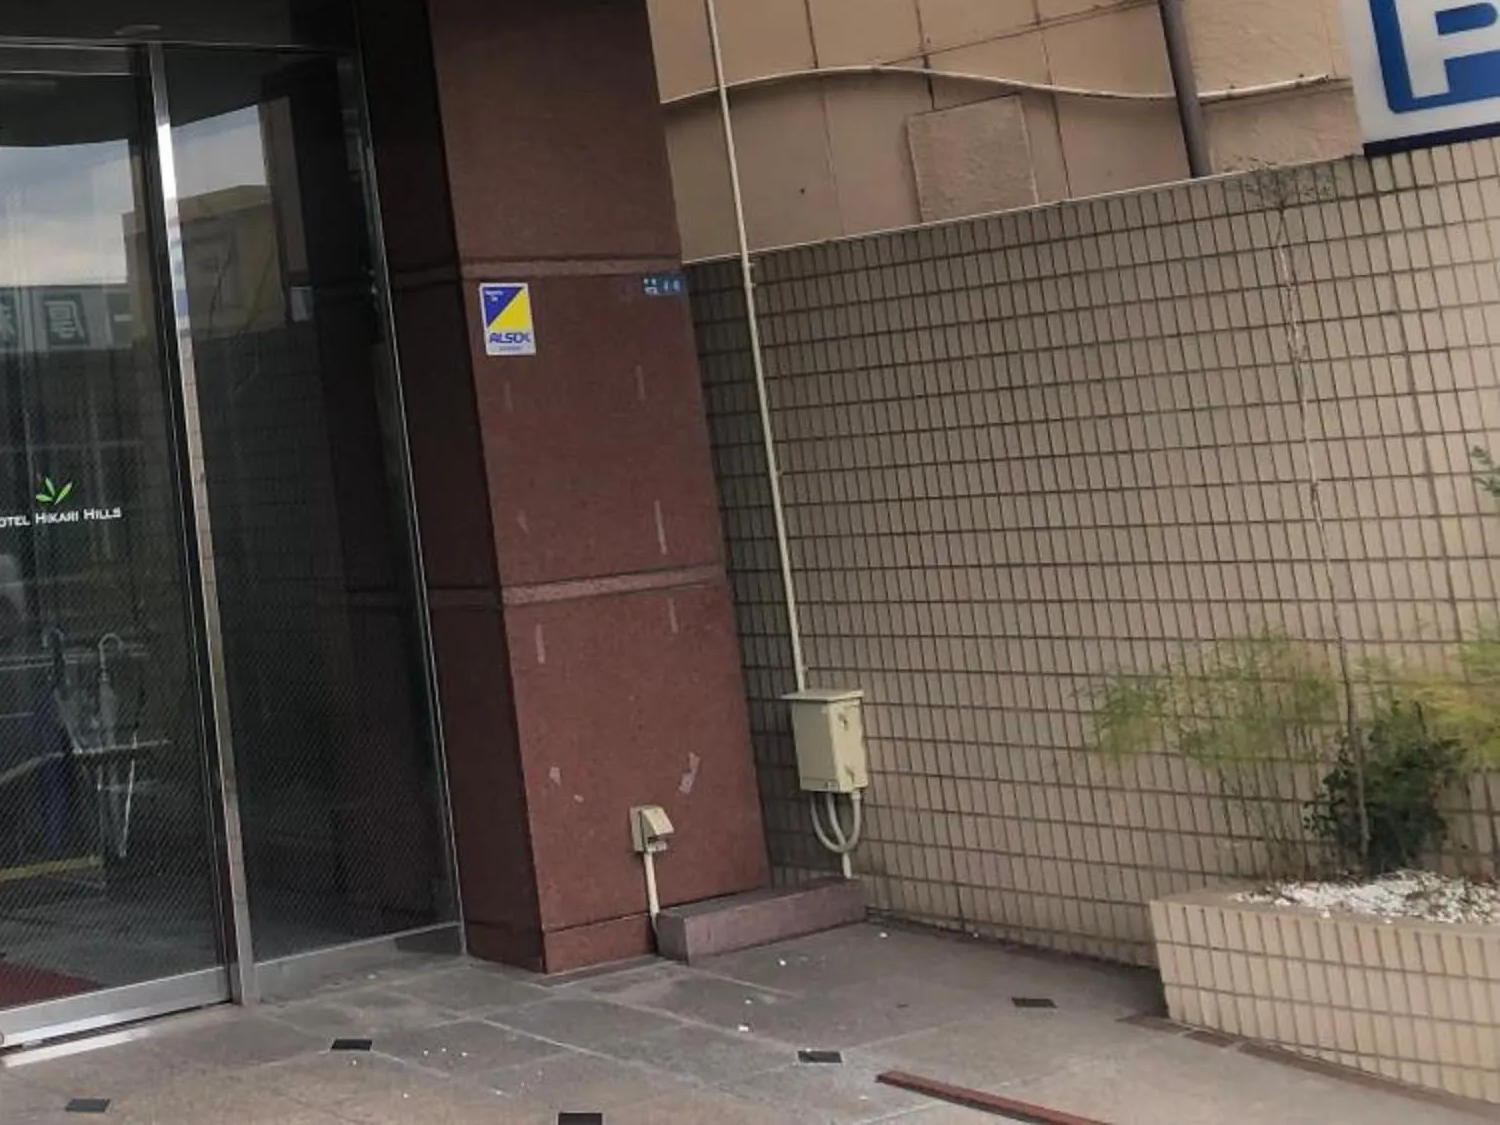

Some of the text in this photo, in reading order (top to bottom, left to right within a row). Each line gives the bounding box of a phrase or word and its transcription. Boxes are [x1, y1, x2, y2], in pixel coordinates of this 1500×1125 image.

[489, 332, 531, 344] ALSOK
[35, 511, 80, 525] HIKARI
[83, 507, 122, 521] HILLS
